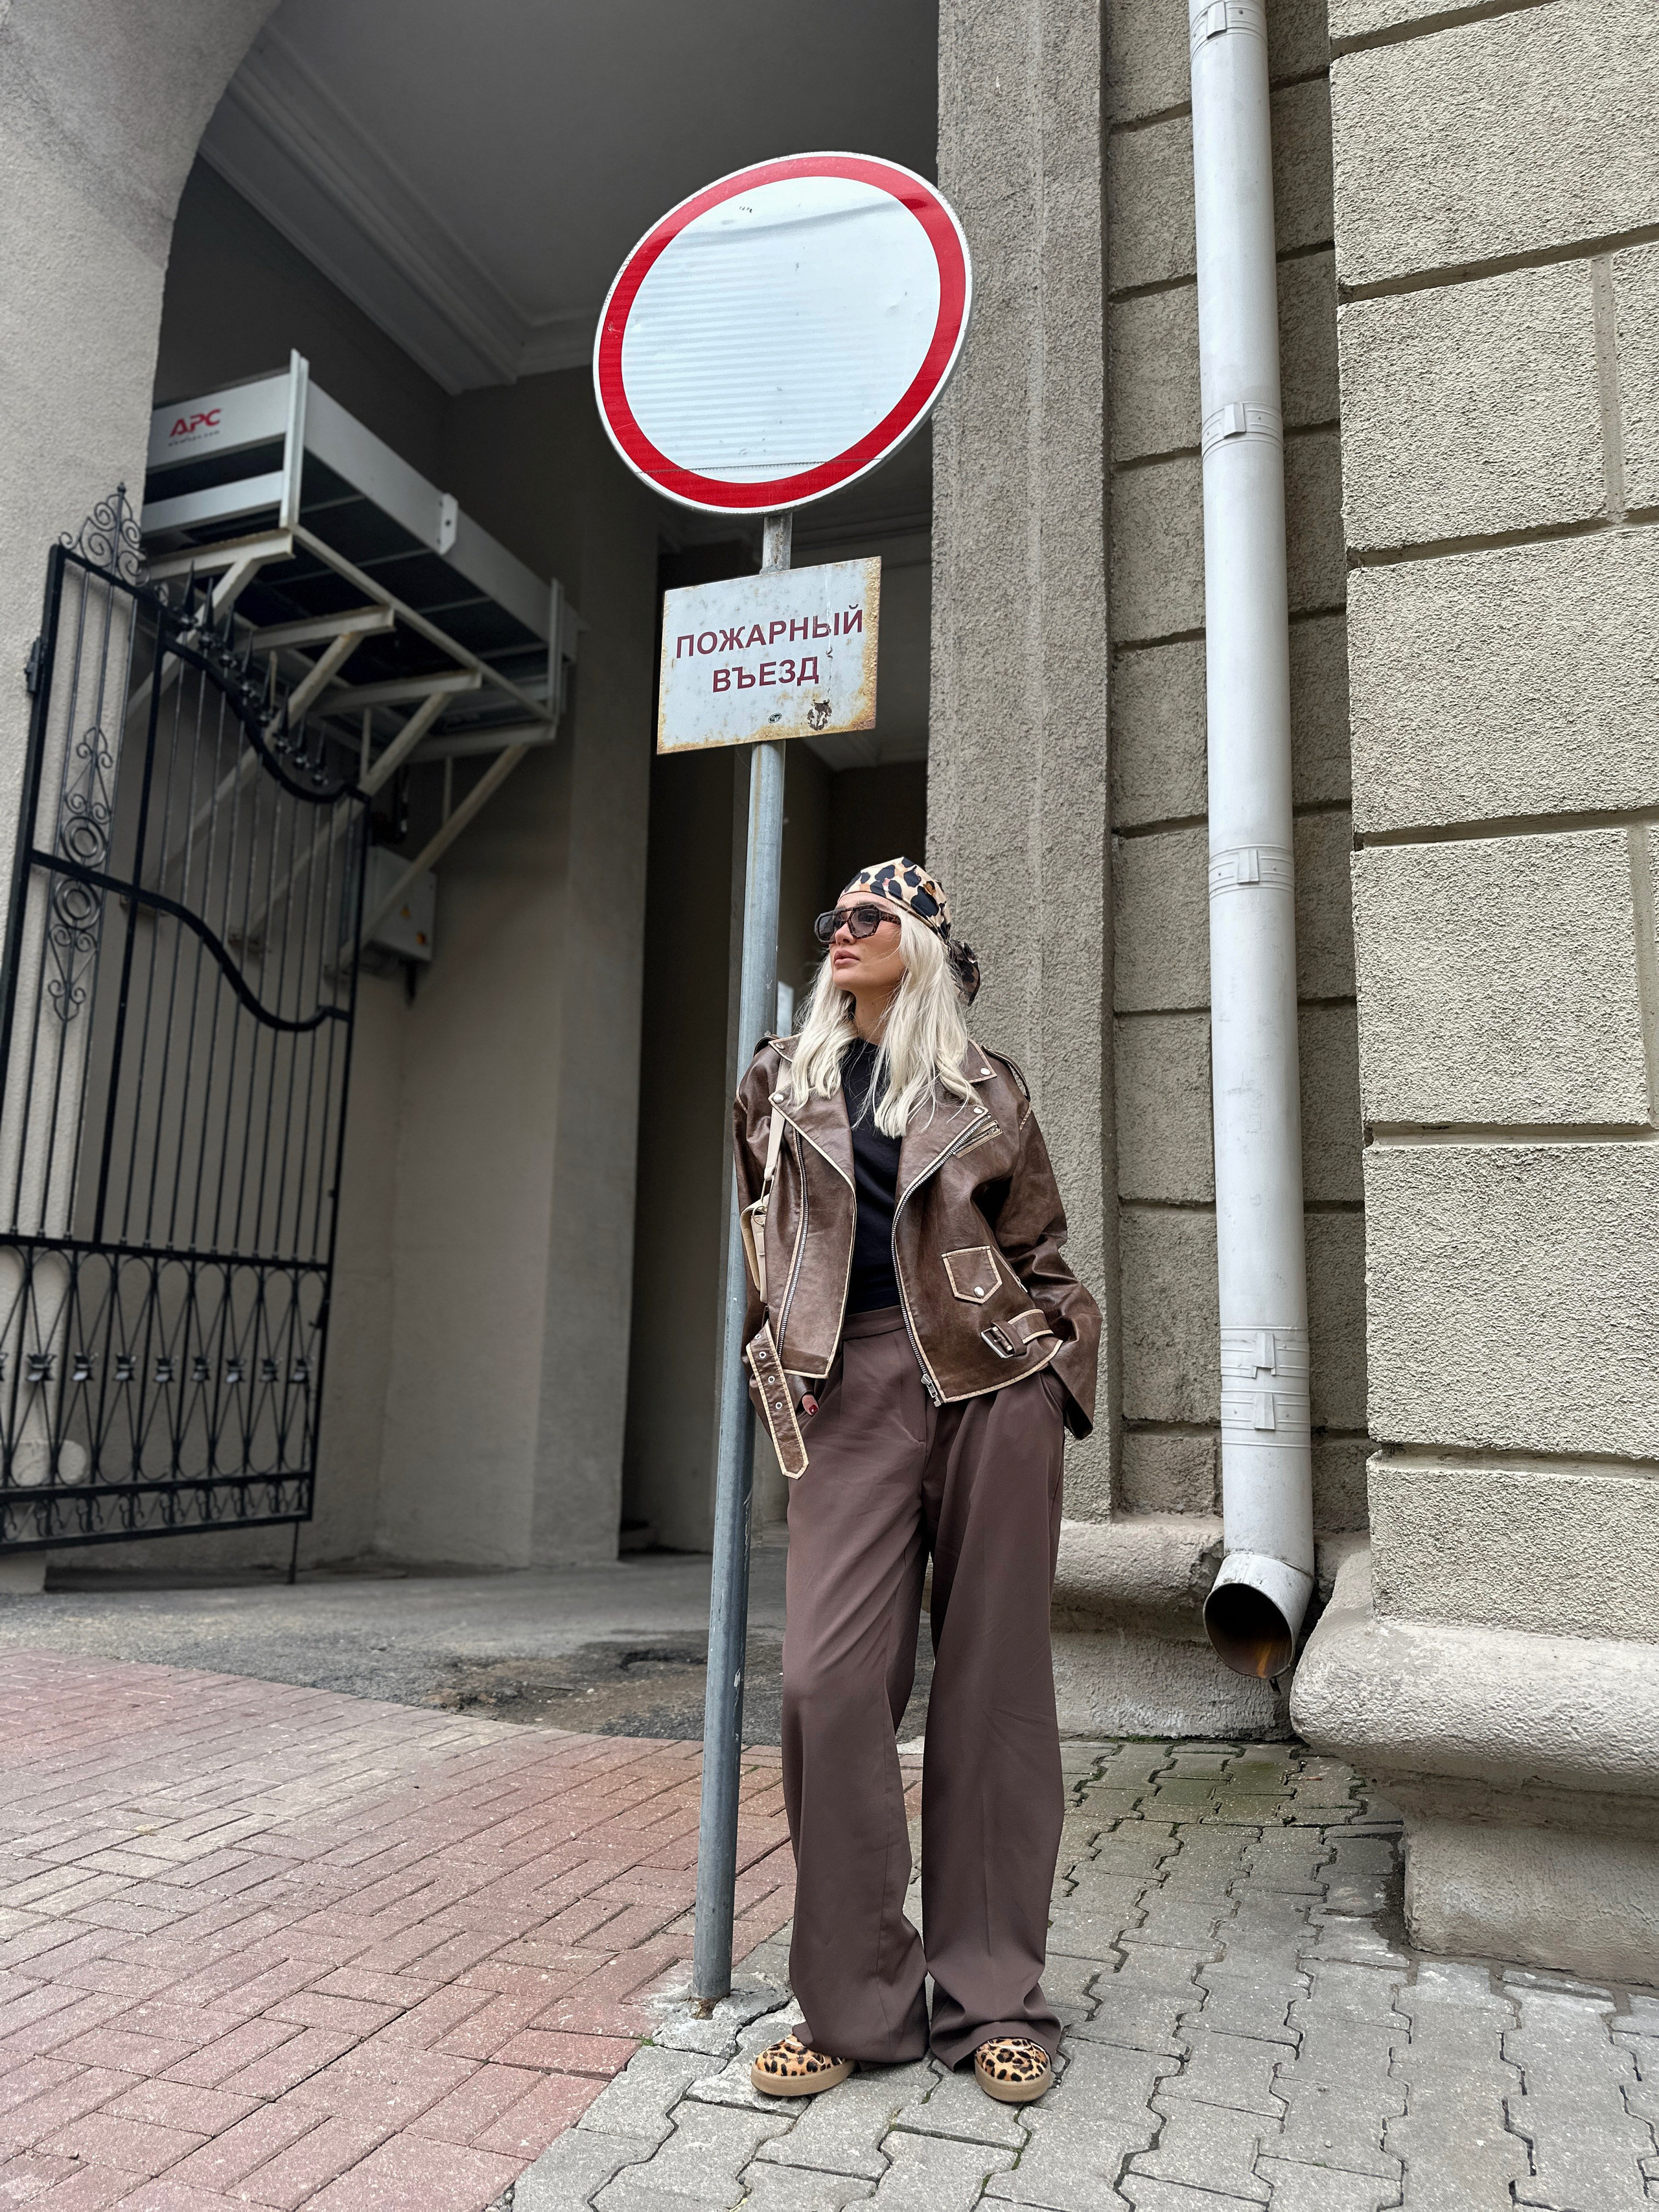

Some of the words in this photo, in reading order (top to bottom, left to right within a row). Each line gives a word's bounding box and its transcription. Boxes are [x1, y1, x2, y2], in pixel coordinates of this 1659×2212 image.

[170, 409, 221, 437] APC
[676, 603, 863, 659] ПОЖАРНЫЙ
[712, 656, 819, 693] ВЪЕЗД
